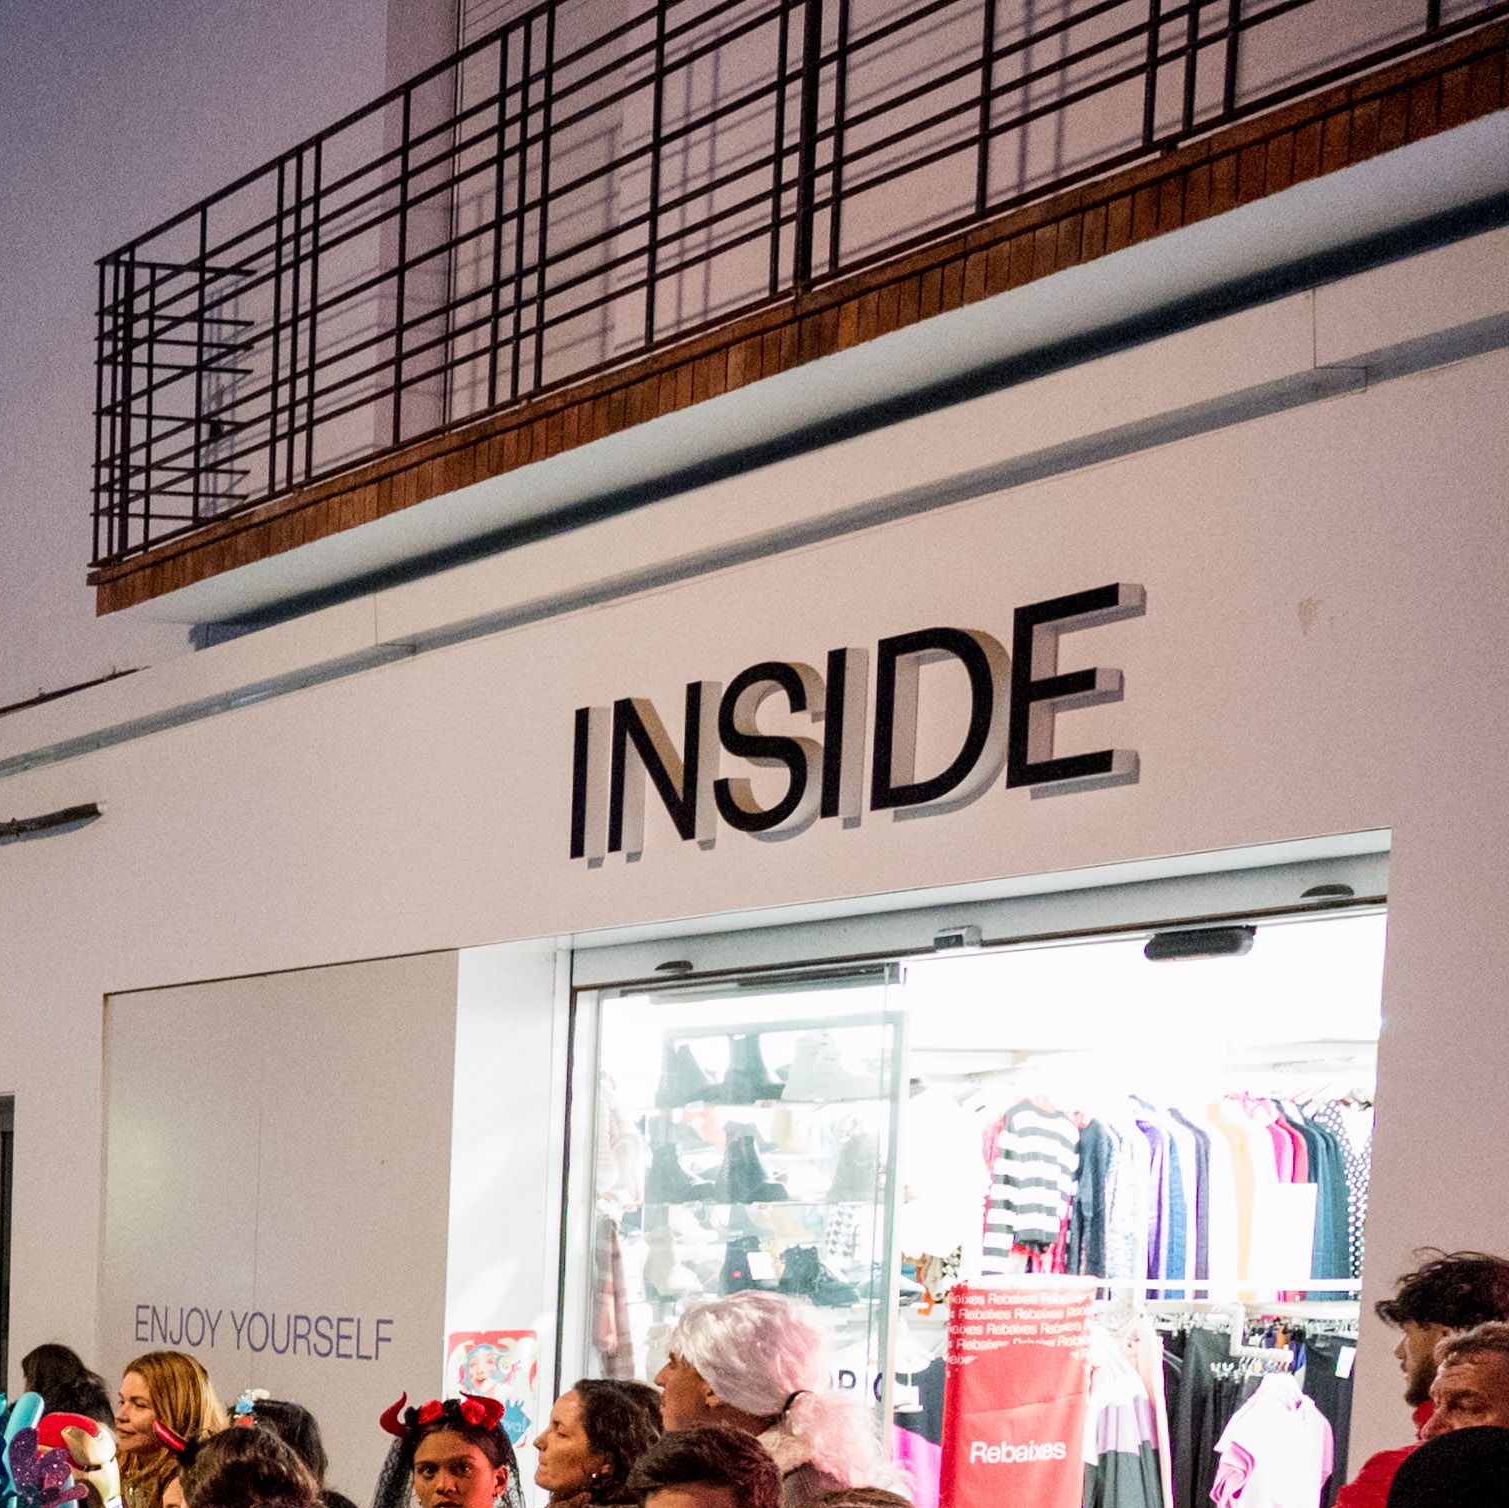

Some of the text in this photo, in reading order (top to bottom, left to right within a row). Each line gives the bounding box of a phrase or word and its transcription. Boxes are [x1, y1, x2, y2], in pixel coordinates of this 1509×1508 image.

[569, 581, 1141, 866] INSIDE
[135, 1304, 394, 1361] ENJOY YOURSELF
[969, 1440, 1067, 1464] Rebaixes
